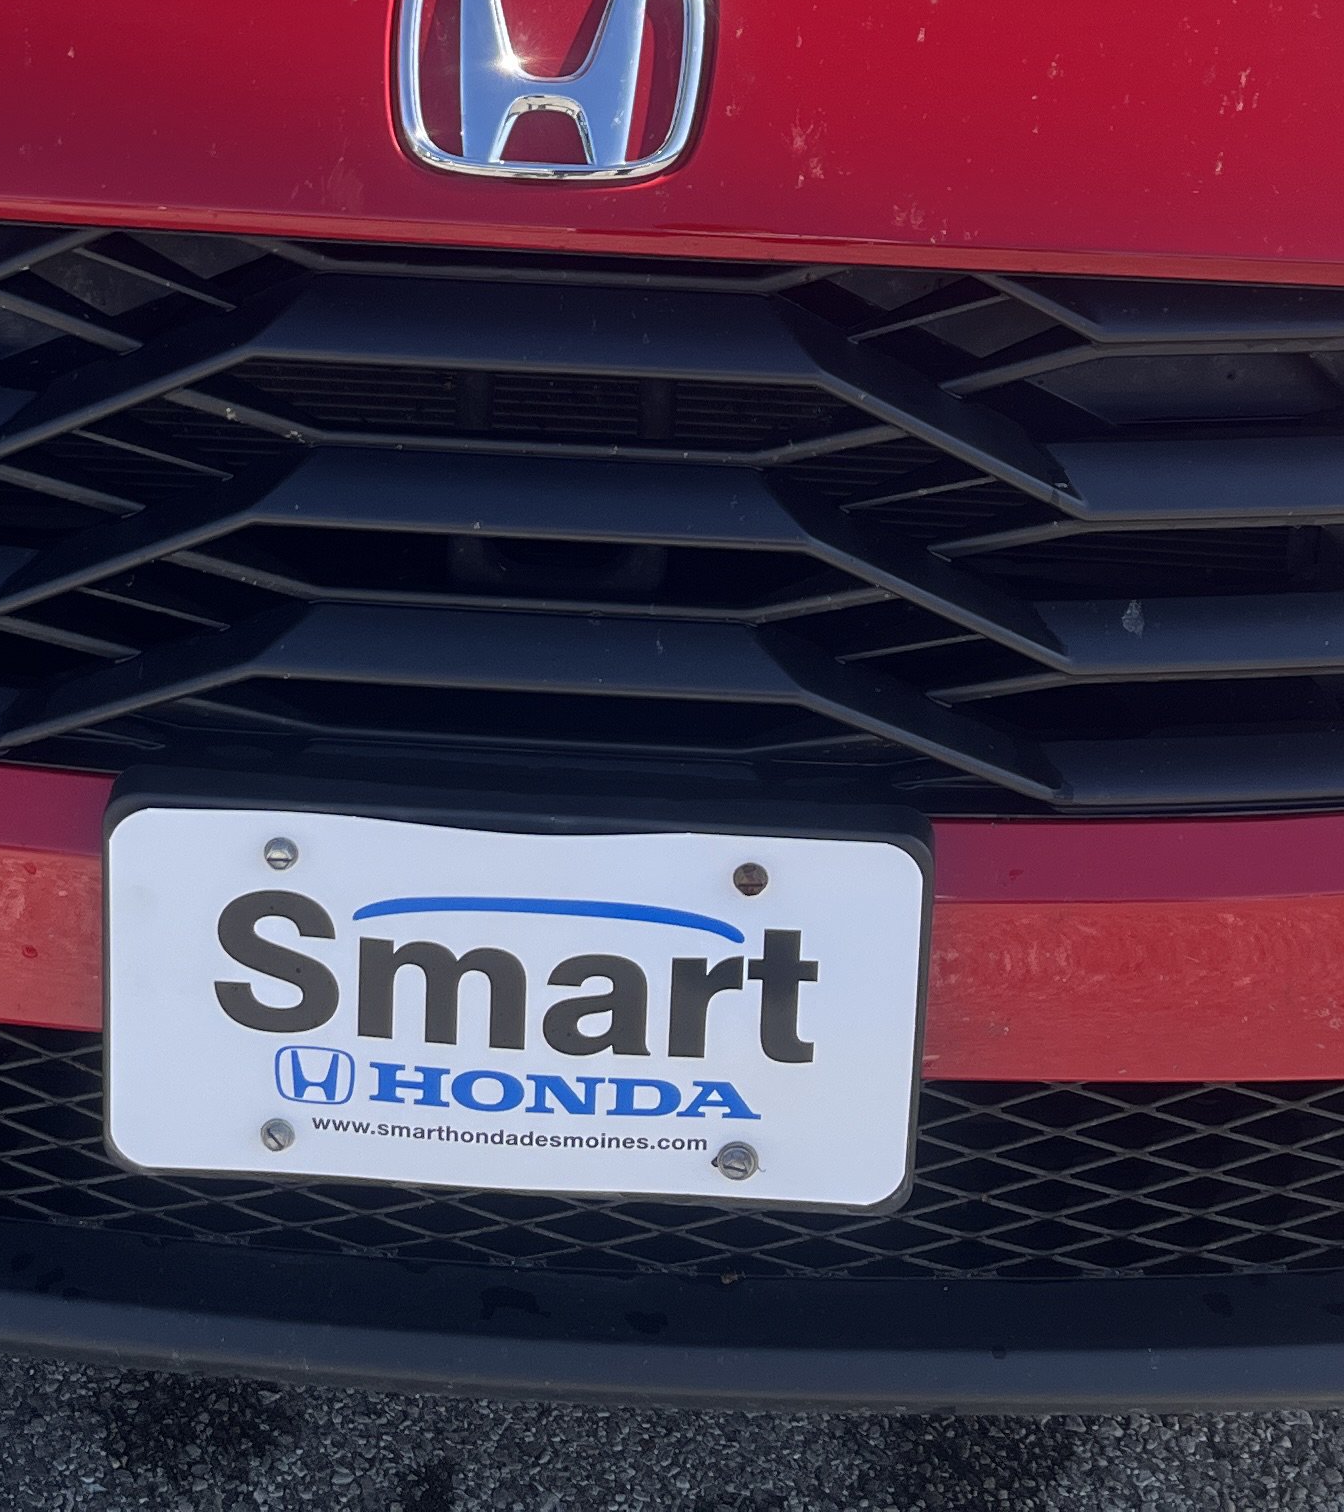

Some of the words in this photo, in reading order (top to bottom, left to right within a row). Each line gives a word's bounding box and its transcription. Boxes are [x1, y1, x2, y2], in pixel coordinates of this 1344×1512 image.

[214, 890, 819, 1064] Smart
[368, 1061, 762, 1120] HONDA
[312, 1116, 708, 1151] www.smarthondadesmoines.com
